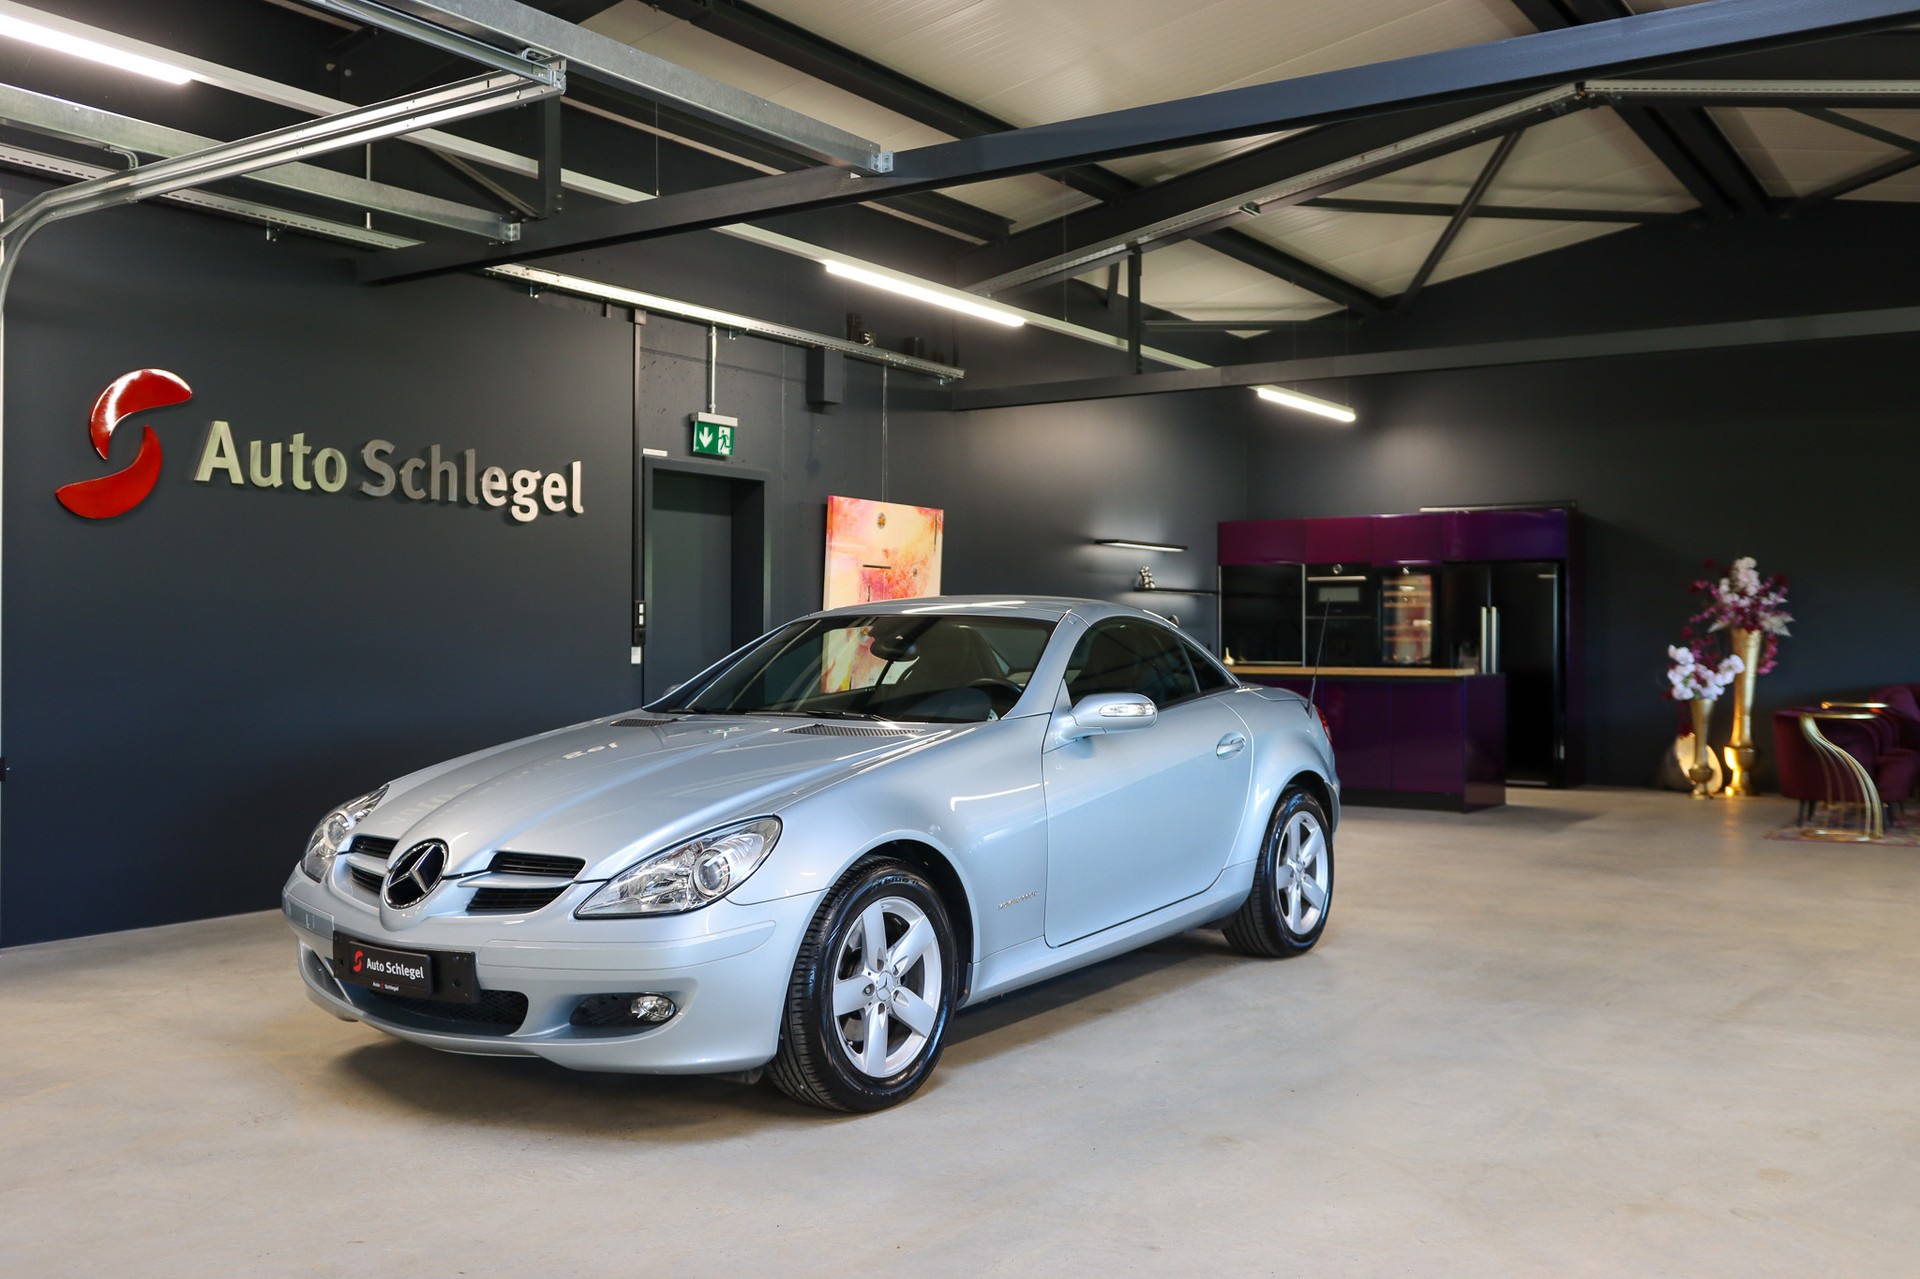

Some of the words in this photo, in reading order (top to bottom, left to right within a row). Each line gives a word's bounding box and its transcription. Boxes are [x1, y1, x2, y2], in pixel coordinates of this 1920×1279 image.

[194, 420, 348, 493] Auto
[359, 438, 584, 523] Schlegel
[367, 958, 384, 972] Auto
[386, 961, 424, 980] Schlegel
